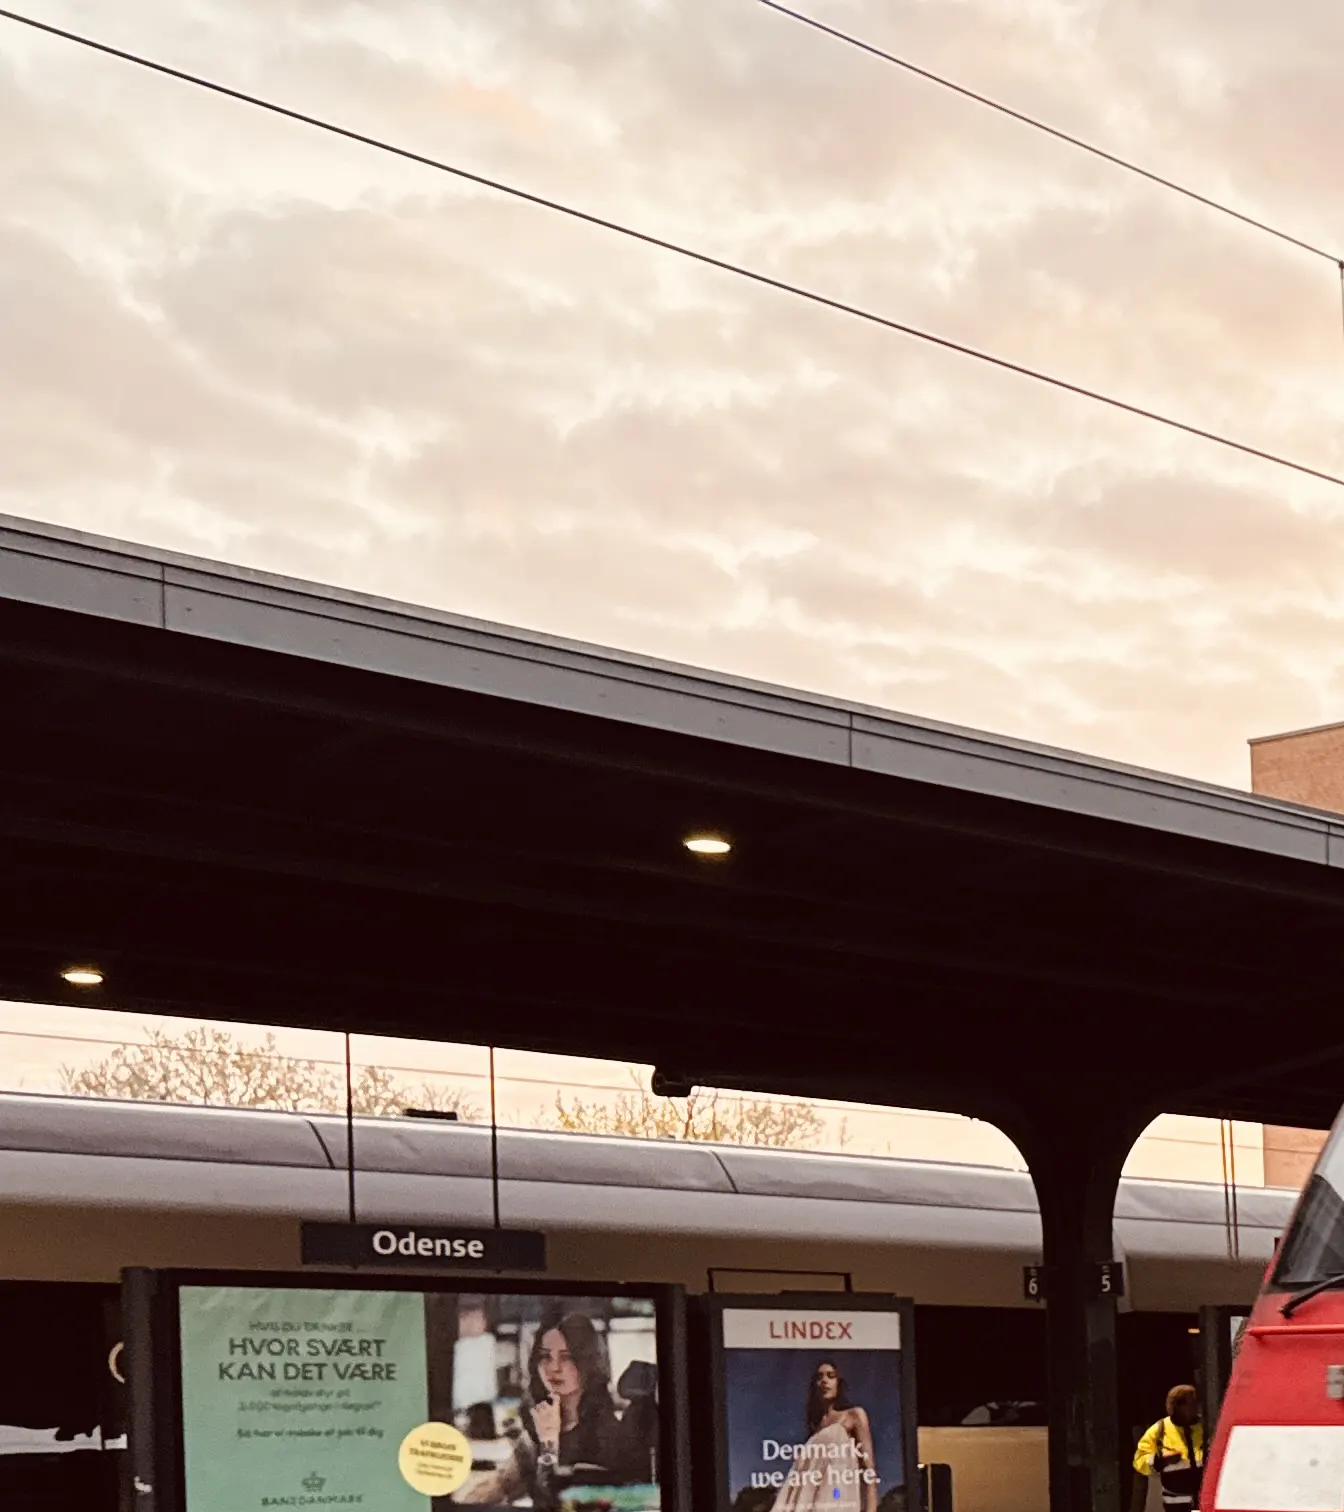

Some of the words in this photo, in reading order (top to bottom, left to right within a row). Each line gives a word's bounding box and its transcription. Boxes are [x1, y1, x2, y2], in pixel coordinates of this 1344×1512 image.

[371, 1230, 485, 1259] Odense
[1028, 1277, 1038, 1295] 6
[1101, 1274, 1111, 1292] 5
[769, 1320, 853, 1340] LINDEX
[228, 1337, 300, 1357] HVOR
[306, 1338, 387, 1357] SVÆRT
[218, 1361, 277, 1380] KAN
[283, 1362, 328, 1380] DET
[333, 1362, 398, 1381] VÆRE
[762, 1437, 869, 1461] Denmark,
[750, 1470, 784, 1488] we
[787, 1468, 823, 1487] are
[827, 1463, 881, 1485] here.
